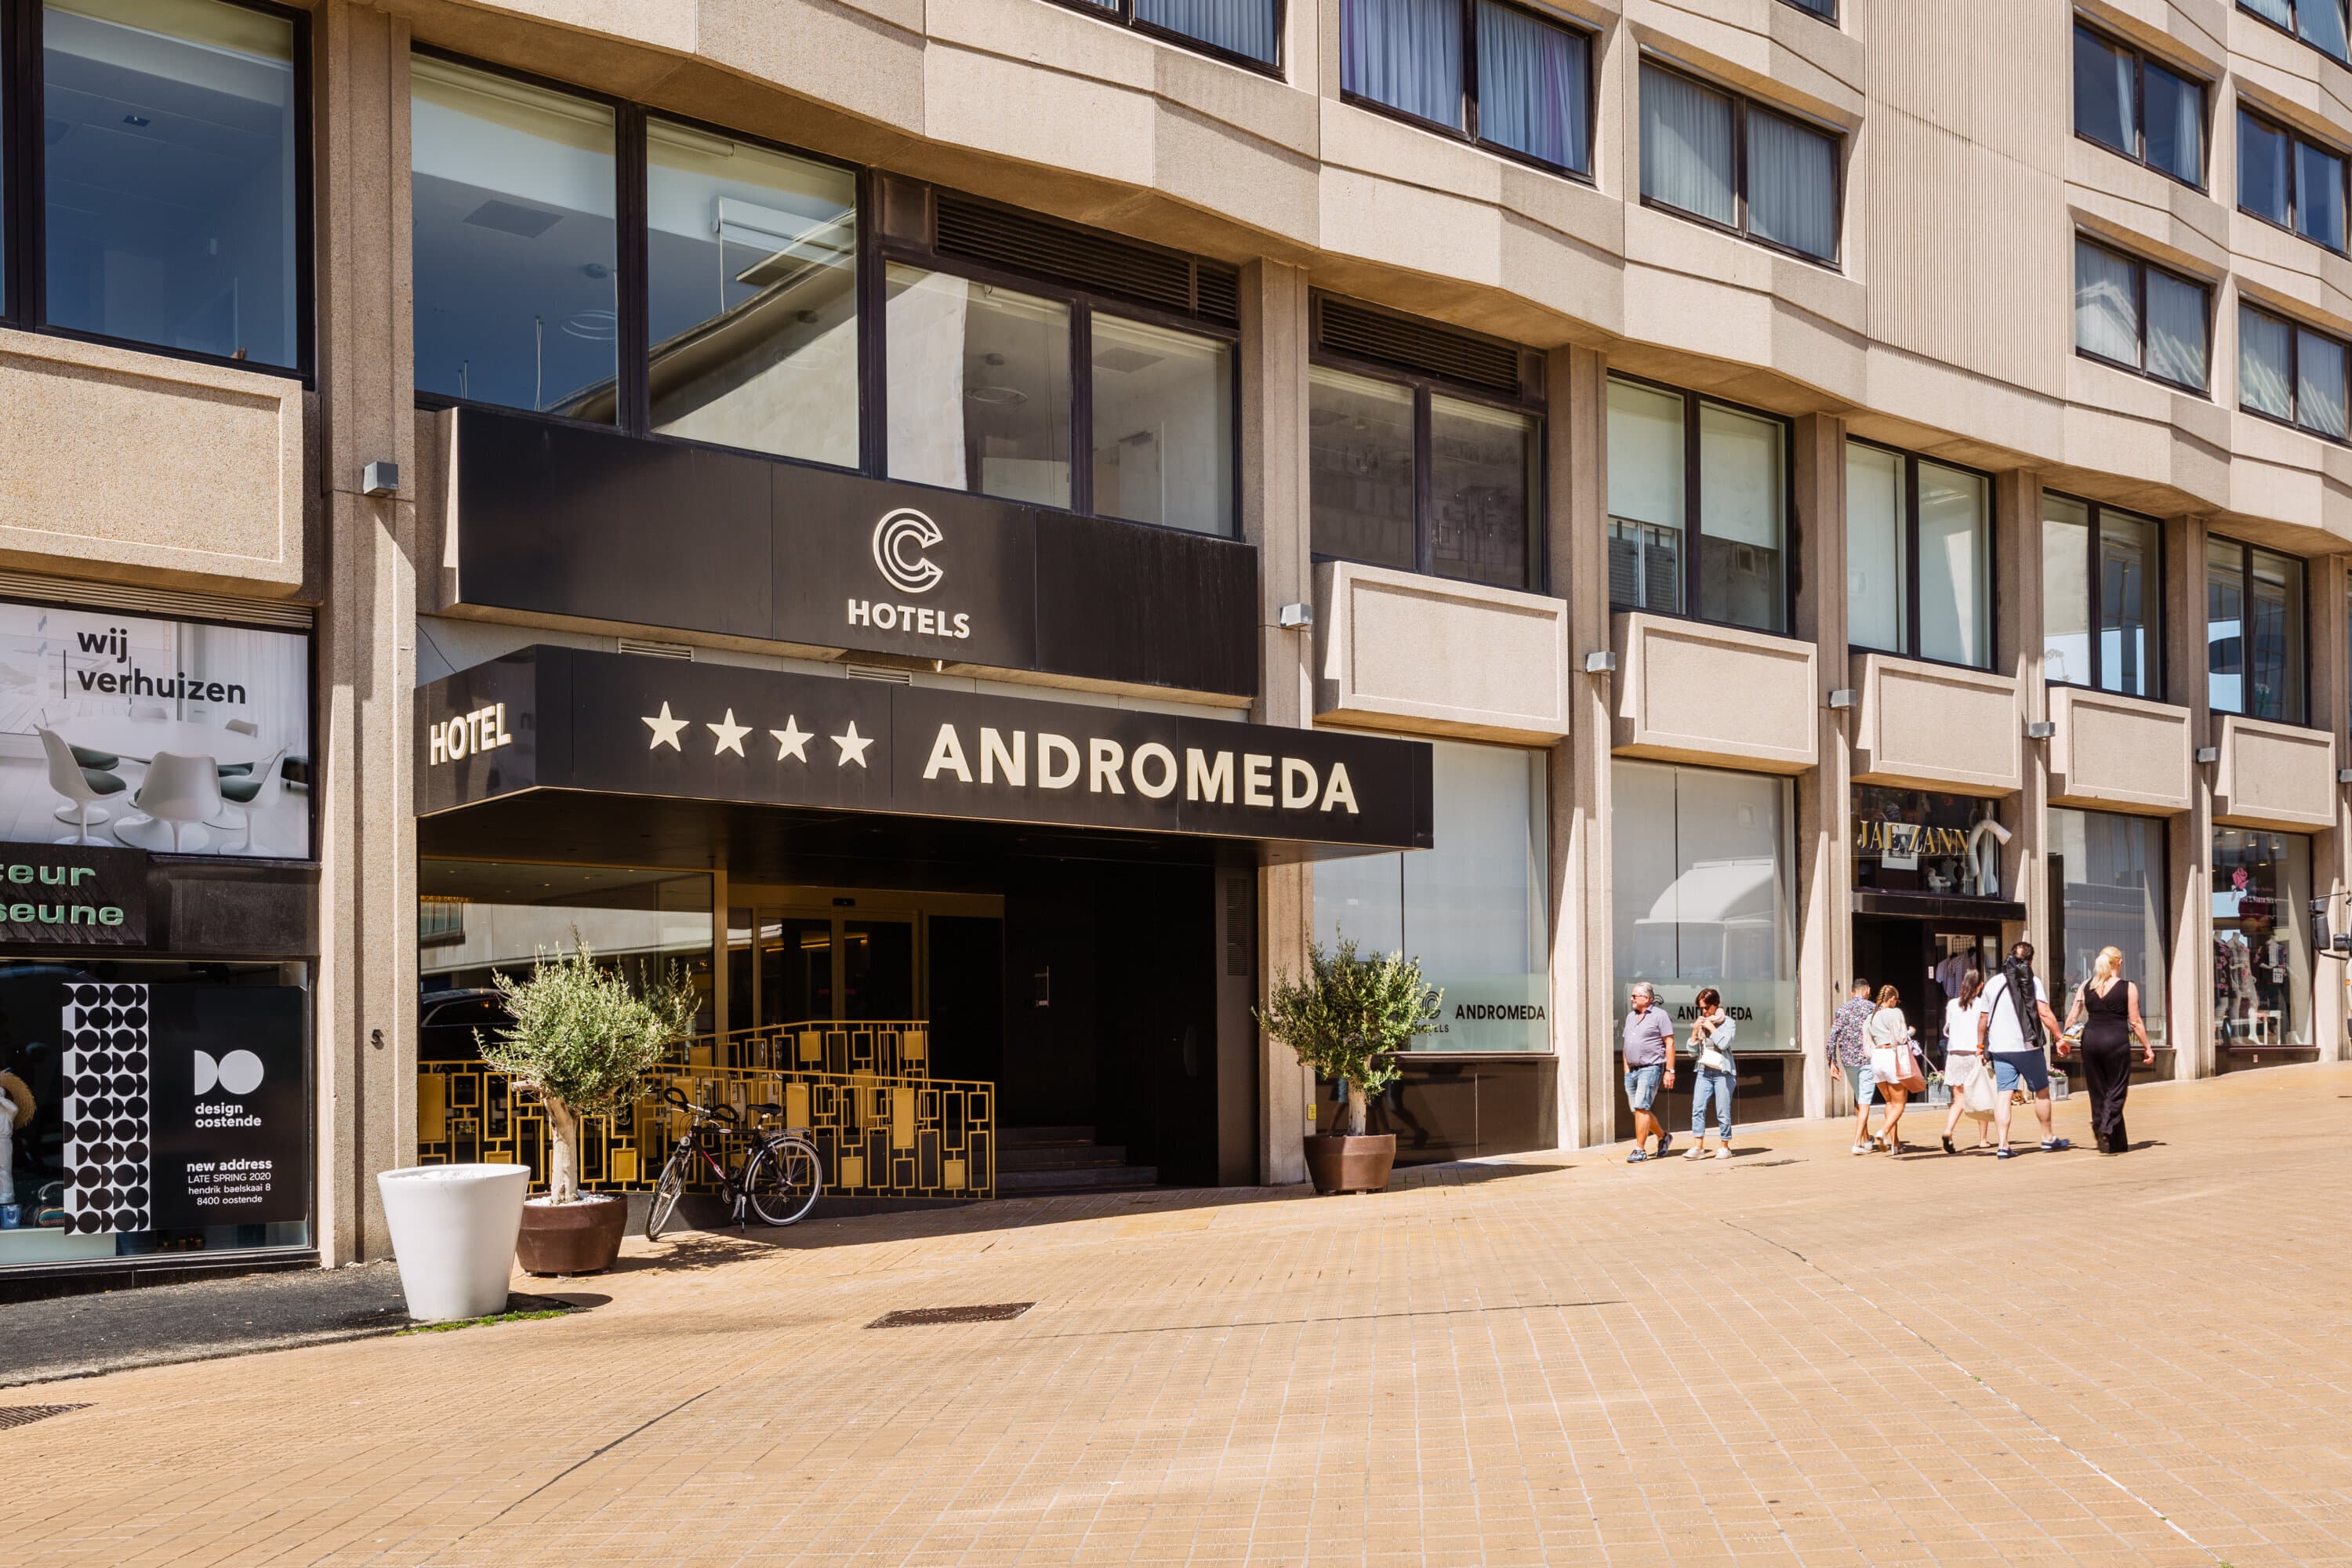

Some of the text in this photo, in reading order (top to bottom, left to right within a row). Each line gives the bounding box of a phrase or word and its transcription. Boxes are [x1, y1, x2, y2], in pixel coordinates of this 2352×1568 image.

[873, 507, 944, 593] C
[848, 598, 971, 639] HOTELS
[76, 627, 129, 663] wij
[76, 667, 246, 705] verhuizen
[430, 702, 514, 766] HOTEL
[922, 723, 1359, 815] ANDROMEDA
[1455, 1004, 1545, 1020] ANDROMEDA
[1677, 1006, 1753, 1021] ANDEDA
[195, 1102, 243, 1116] design
[195, 1115, 262, 1128] oostende
[187, 1159, 273, 1172] new address
[188, 1172, 271, 1184] LATE SPRING 2020
[188, 1183, 271, 1195] hendrik baelskaai 8
[197, 1195, 263, 1206] 8400 oostende
